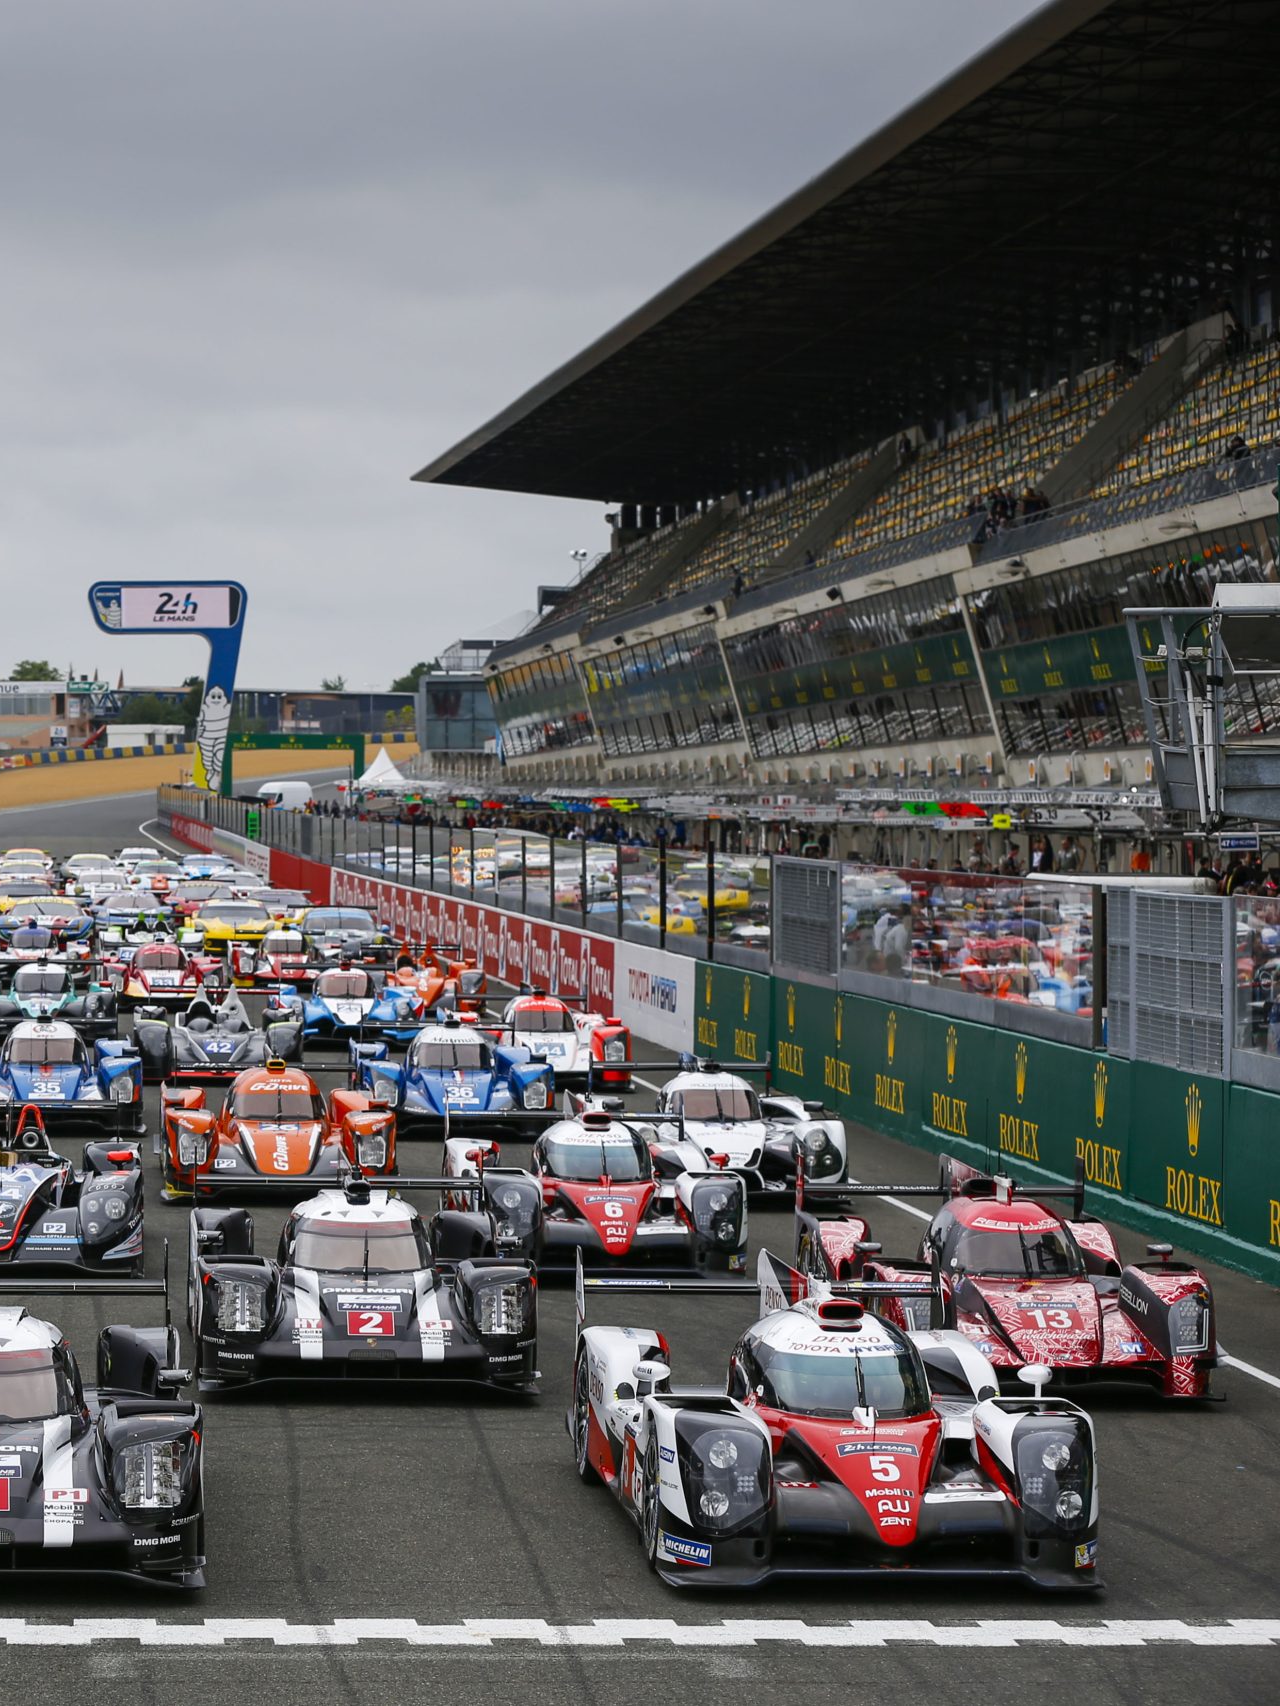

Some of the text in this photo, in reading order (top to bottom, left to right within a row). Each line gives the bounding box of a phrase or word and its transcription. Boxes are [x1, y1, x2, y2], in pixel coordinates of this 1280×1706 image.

[1098, 810, 1111, 821] 12
[531, 939, 549, 979] TOTAL
[560, 948, 579, 988] TOTAL
[591, 957, 613, 1000] TOTAL
[628, 969, 677, 1013] TOYOTA HYBRID
[519, 1001, 562, 1009] MANOR
[698, 1017, 718, 1048] ROLEX
[431, 1036, 476, 1044] Matmut
[734, 1028, 757, 1061] ROLEX
[206, 1042, 234, 1054] 42
[541, 1045, 562, 1056] 44
[778, 1040, 804, 1077] ROLEX
[824, 1055, 851, 1096] ROLEX
[33, 1082, 61, 1094] 35
[447, 1086, 473, 1099] 36
[875, 1073, 905, 1114] ROLEX
[933, 1092, 968, 1136] ROLEX
[261, 1123, 299, 1131] 26
[999, 1113, 1040, 1161] ROLEX
[216, 1159, 236, 1168] P2
[1075, 1137, 1122, 1190] ROLEX
[1165, 1166, 1222, 1226] ROLEX
[604, 1202, 624, 1218] 6
[45, 1223, 65, 1232] P2
[973, 1217, 1061, 1229] REBELLION
[606, 1236, 627, 1244] ZENT
[367, 1287, 413, 1295] MORI
[294, 1318, 319, 1329] HY
[358, 1312, 384, 1334] 2
[425, 1321, 451, 1329] P1
[1027, 1309, 1073, 1329] 13
[811, 1335, 881, 1344] DENSO
[789, 1342, 904, 1353] TOYOTA HYBRID
[218, 1351, 232, 1359] DMG
[507, 1354, 523, 1362] MORI
[589, 1371, 605, 1404] DENSO
[843, 1443, 865, 1453] 24h
[880, 1445, 913, 1453] MANS
[870, 1455, 901, 1482] 5
[52, 1490, 80, 1500] P1
[865, 1488, 901, 1498] Mobil
[880, 1517, 912, 1526] ZENT
[133, 1534, 181, 1547] DMG MORI
[665, 1538, 710, 1559] MICHELIN
